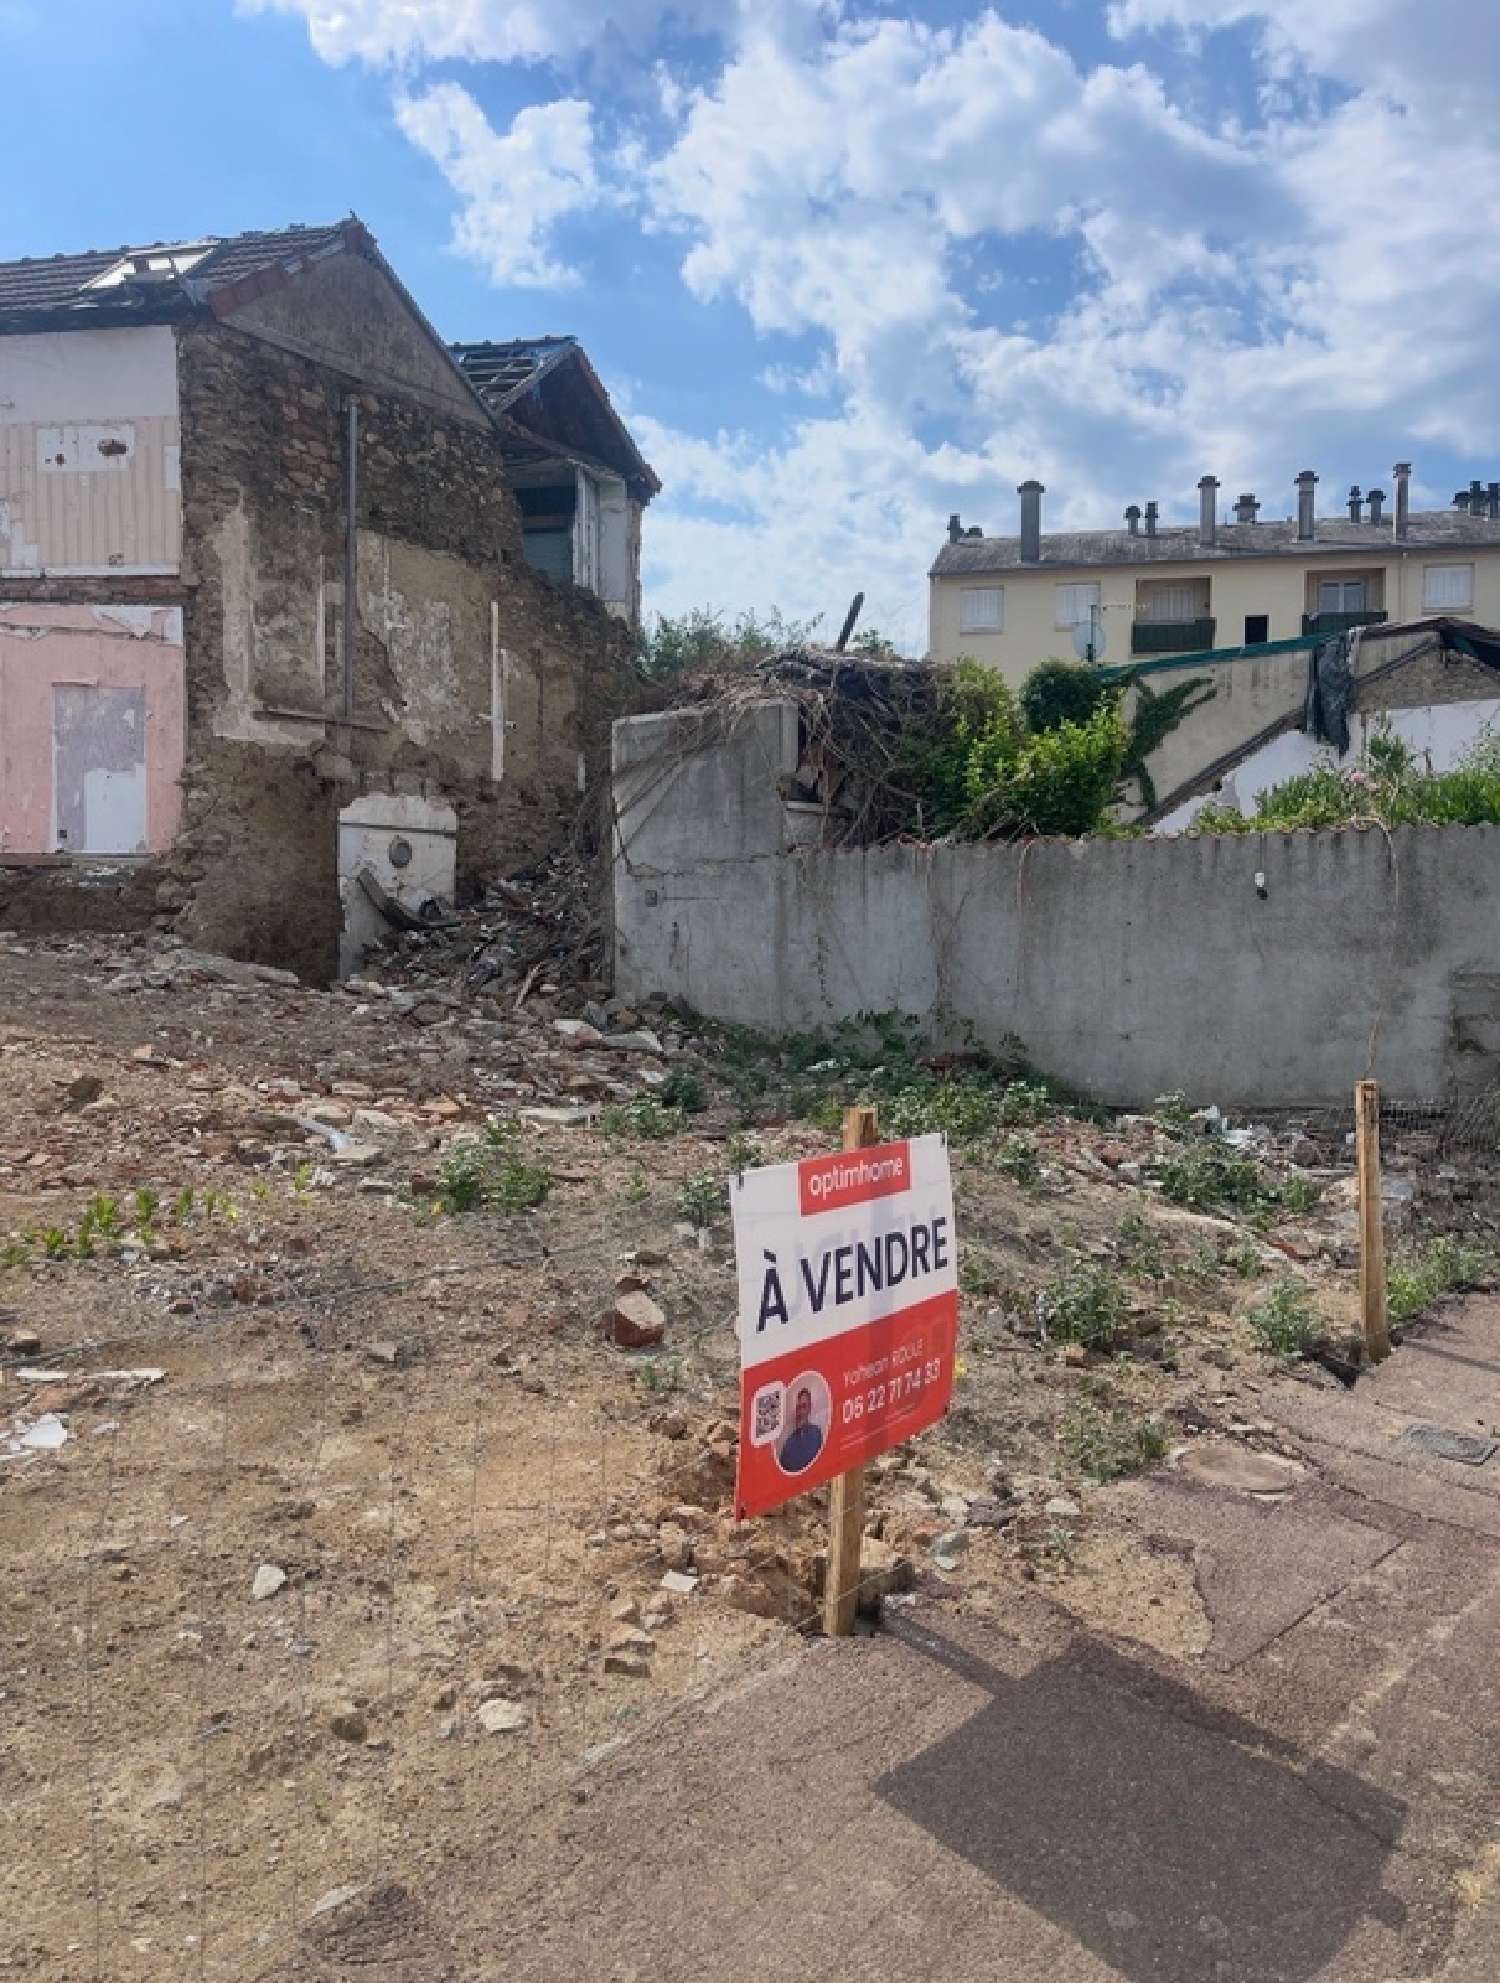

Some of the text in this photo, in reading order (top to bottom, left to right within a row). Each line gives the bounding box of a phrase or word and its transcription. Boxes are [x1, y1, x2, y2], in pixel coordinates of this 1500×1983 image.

[809, 1158, 902, 1200] optimhome
[757, 1216, 947, 1333] À VENDRE
[843, 1395, 863, 1423] 06
[868, 1384, 886, 1413] 22
